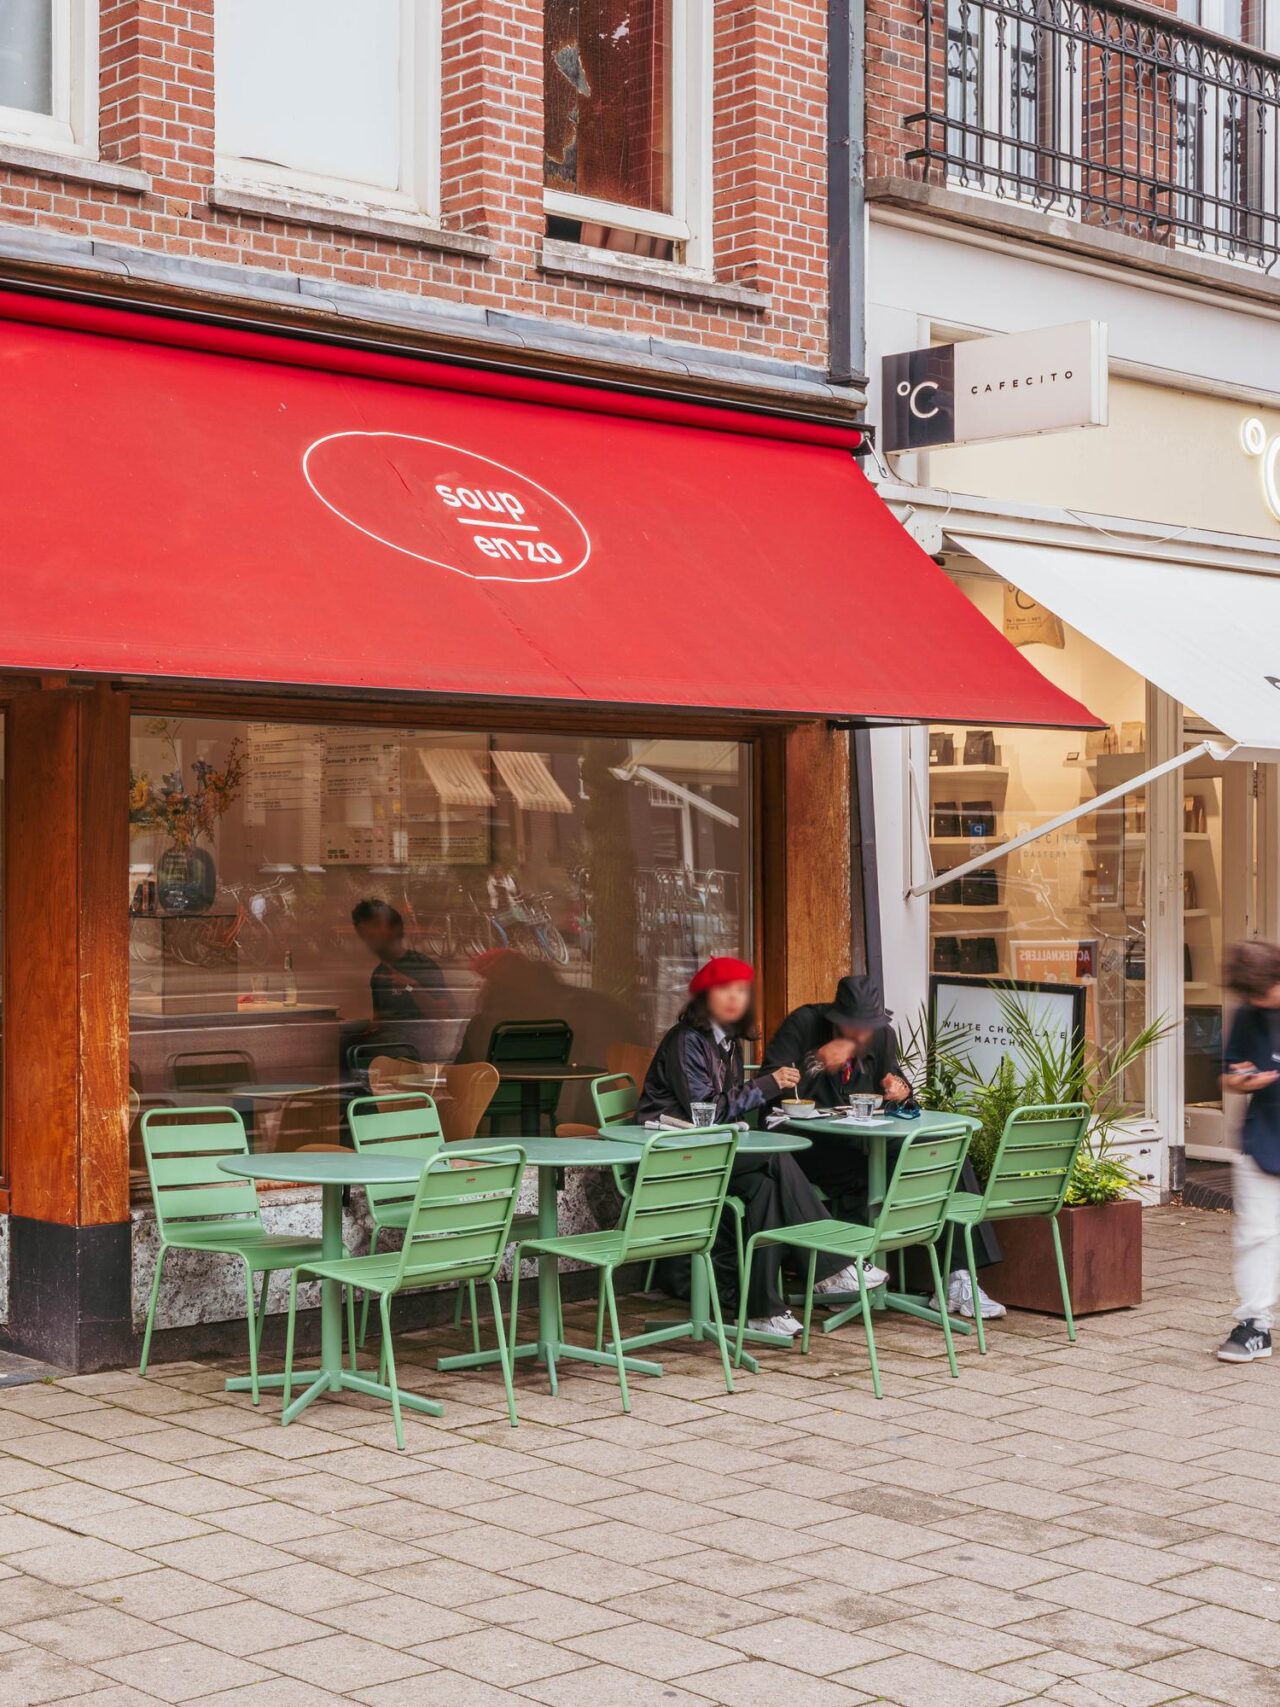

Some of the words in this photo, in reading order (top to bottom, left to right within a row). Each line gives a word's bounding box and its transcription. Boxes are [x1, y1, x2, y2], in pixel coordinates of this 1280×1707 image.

[970, 371, 1073, 394] CAFECITO
[435, 484, 525, 522] soup
[942, 1020, 981, 1031] WHITE
